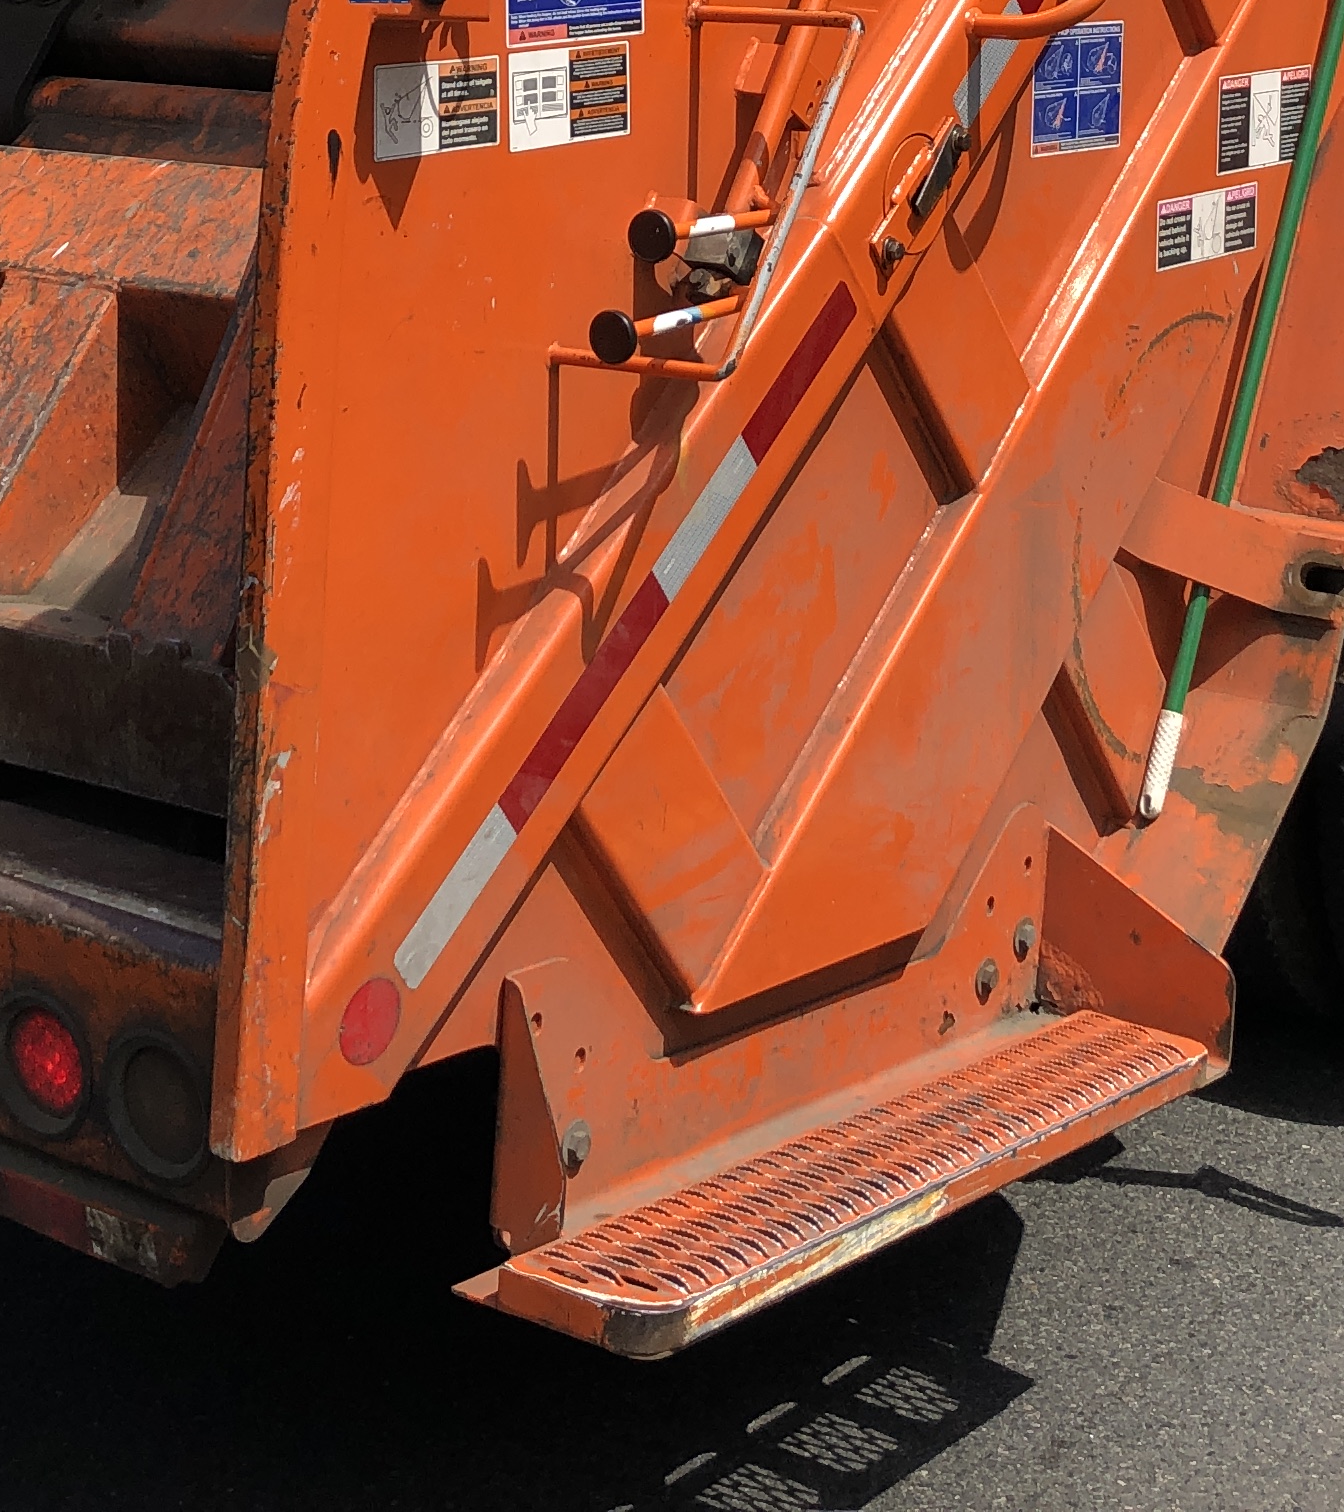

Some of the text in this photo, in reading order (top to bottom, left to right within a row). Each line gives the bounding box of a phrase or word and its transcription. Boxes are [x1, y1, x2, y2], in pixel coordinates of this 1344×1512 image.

[528, 29, 555, 38] WARNING
[456, 62, 488, 74] WARNING
[1226, 77, 1250, 90] DANGER
[1231, 186, 1255, 200] PELIGRO
[1165, 199, 1191, 214] DANGER
